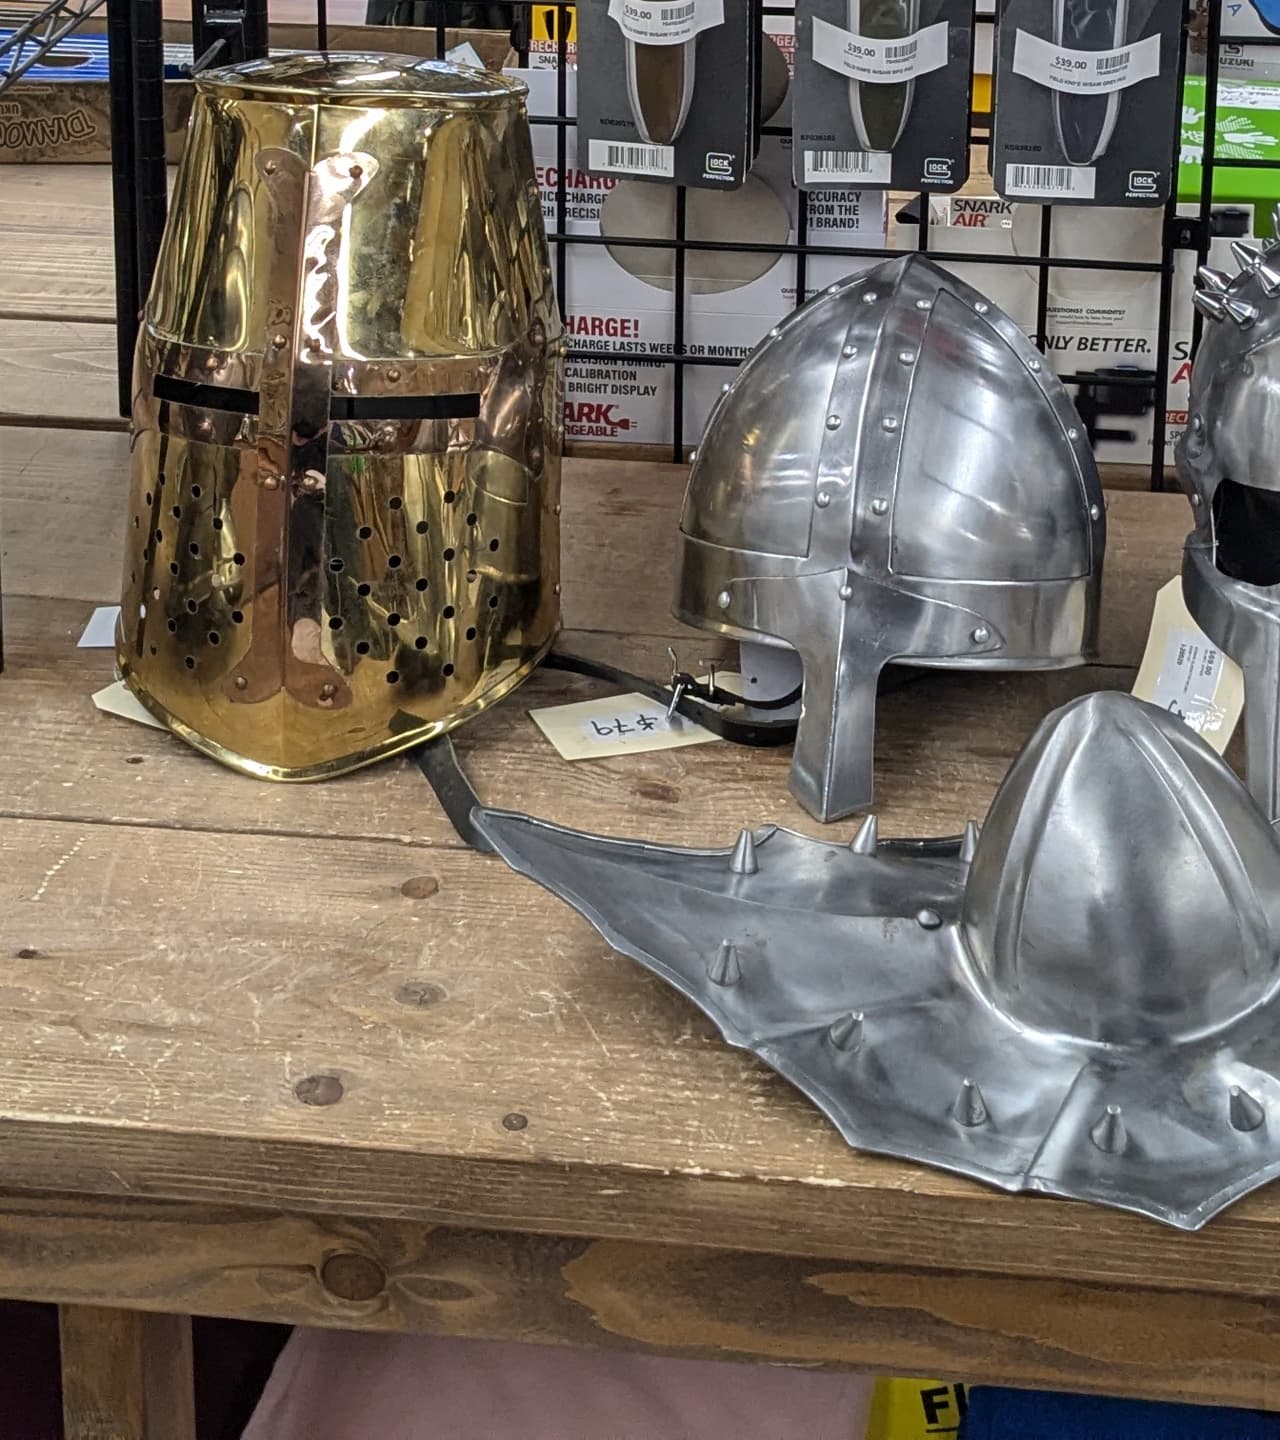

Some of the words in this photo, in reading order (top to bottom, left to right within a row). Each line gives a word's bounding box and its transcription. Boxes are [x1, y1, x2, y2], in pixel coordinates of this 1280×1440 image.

[1054, 56, 1088, 71] $39.00
[1219, 57, 1254, 68] UZUKI
[566, 192, 608, 204] CHARGE
[806, 190, 862, 203] CCURACY
[838, 204, 859, 216] THE
[953, 200, 1014, 214] SNARK
[816, 216, 860, 228] BRAND!
[952, 213, 989, 228] AIR
[564, 315, 640, 338] HARGE!
[566, 339, 611, 352] CHARGE
[613, 340, 646, 352] LASTS
[650, 341, 688, 355] WEES
[690, 344, 705, 355] OR
[1077, 336, 1152, 354] BETTER.
[564, 368, 637, 382] CALIBRATION
[568, 382, 608, 394] BRIGHT
[611, 383, 657, 396] DISPLAY
[564, 402, 614, 424] ARK
